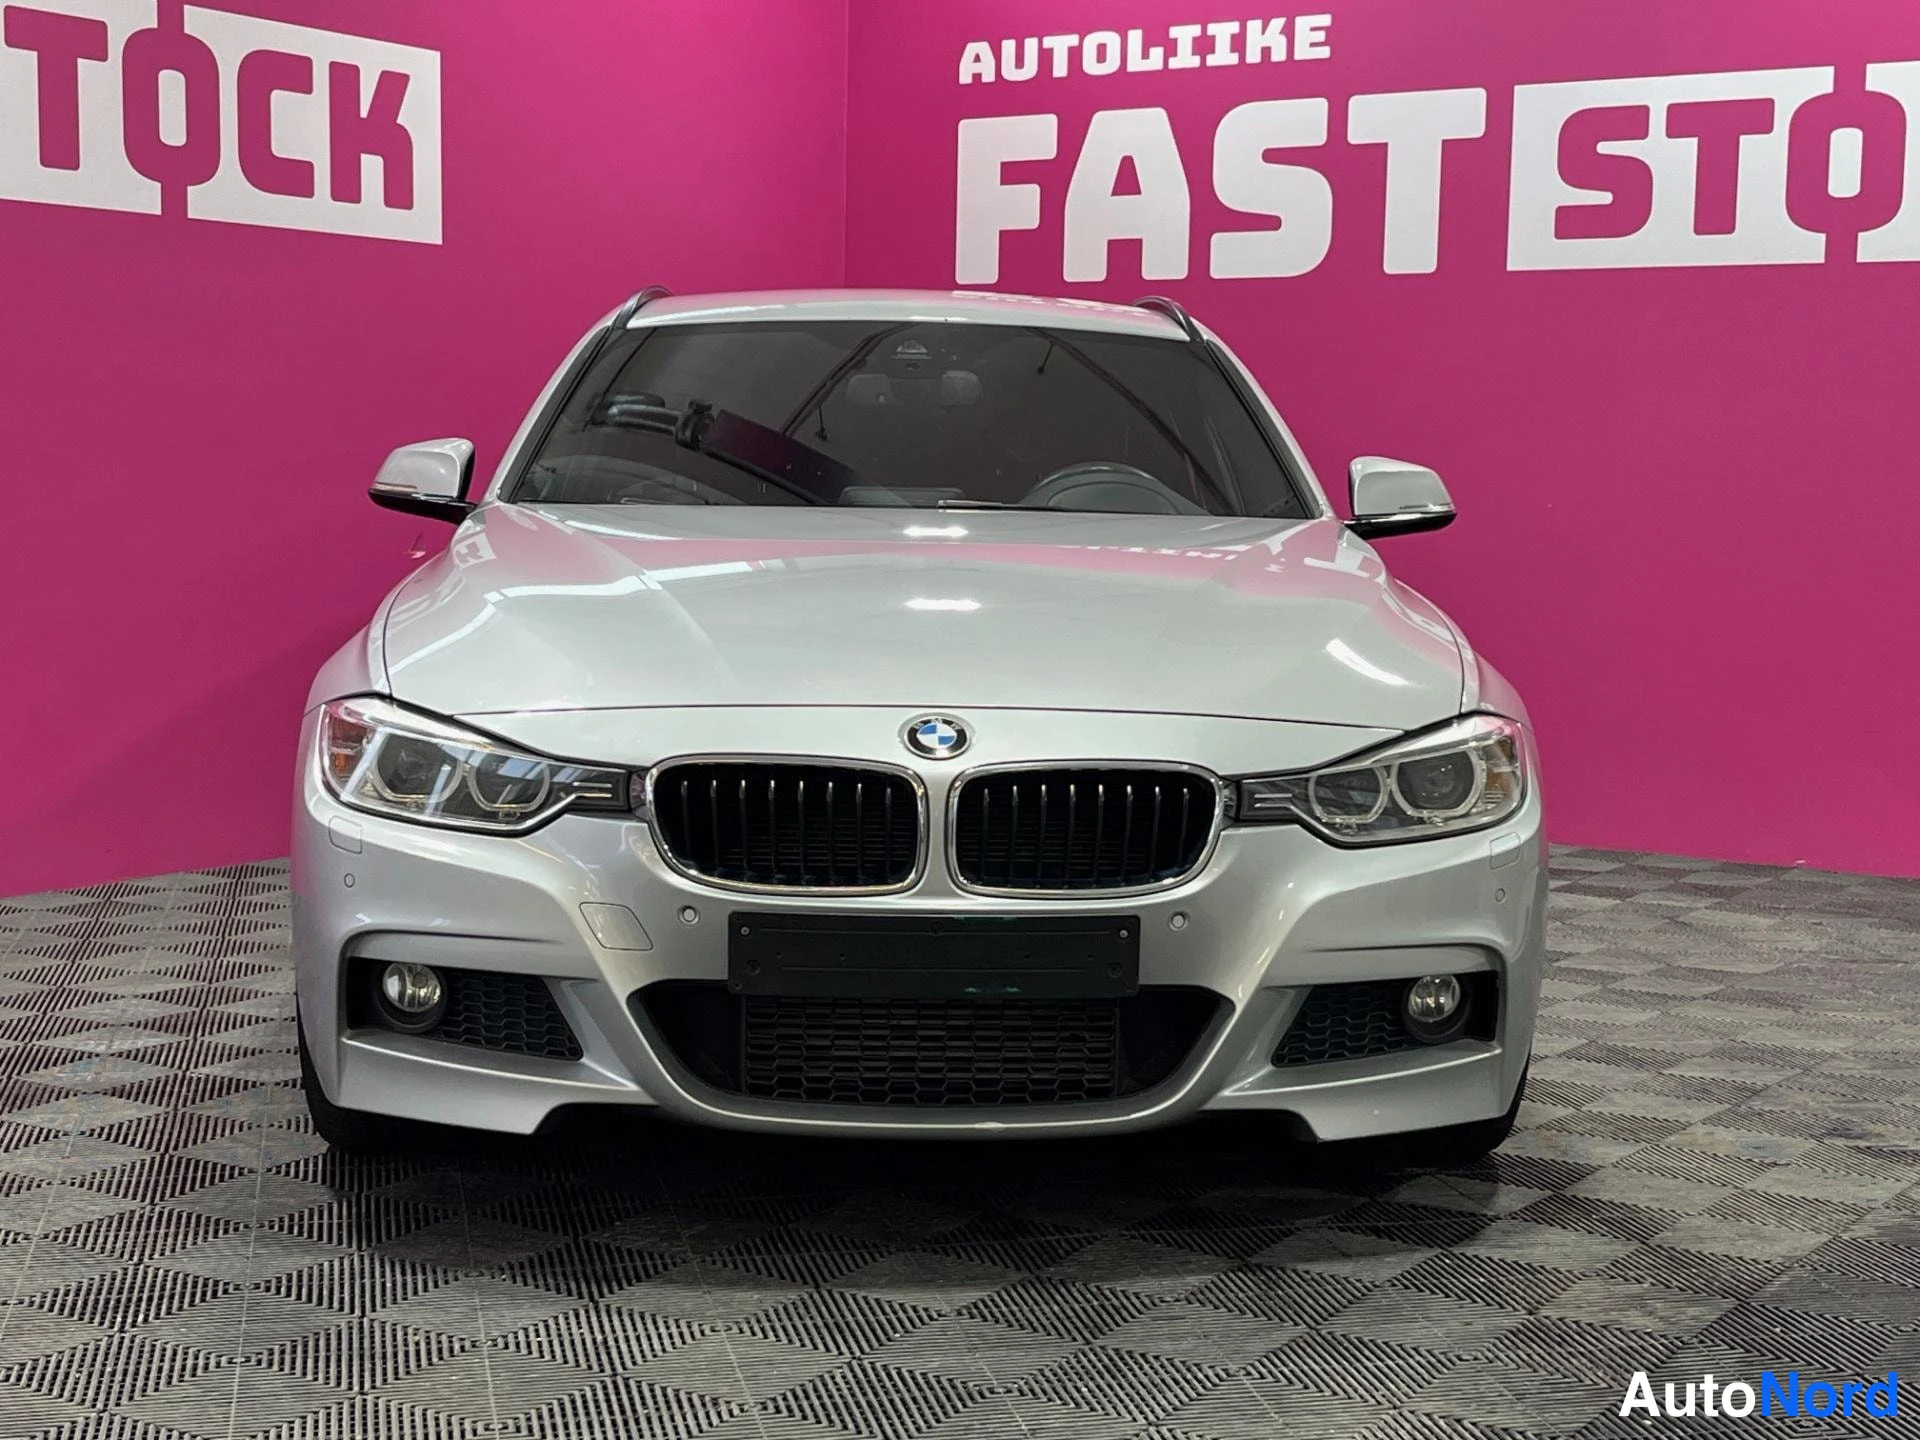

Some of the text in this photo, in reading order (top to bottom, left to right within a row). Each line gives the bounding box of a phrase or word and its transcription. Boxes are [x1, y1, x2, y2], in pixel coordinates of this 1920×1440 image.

[3, 4, 415, 211] TOCK
[958, 13, 1332, 85] AUTOLIIKE
[955, 87, 1908, 285] FAST STO
